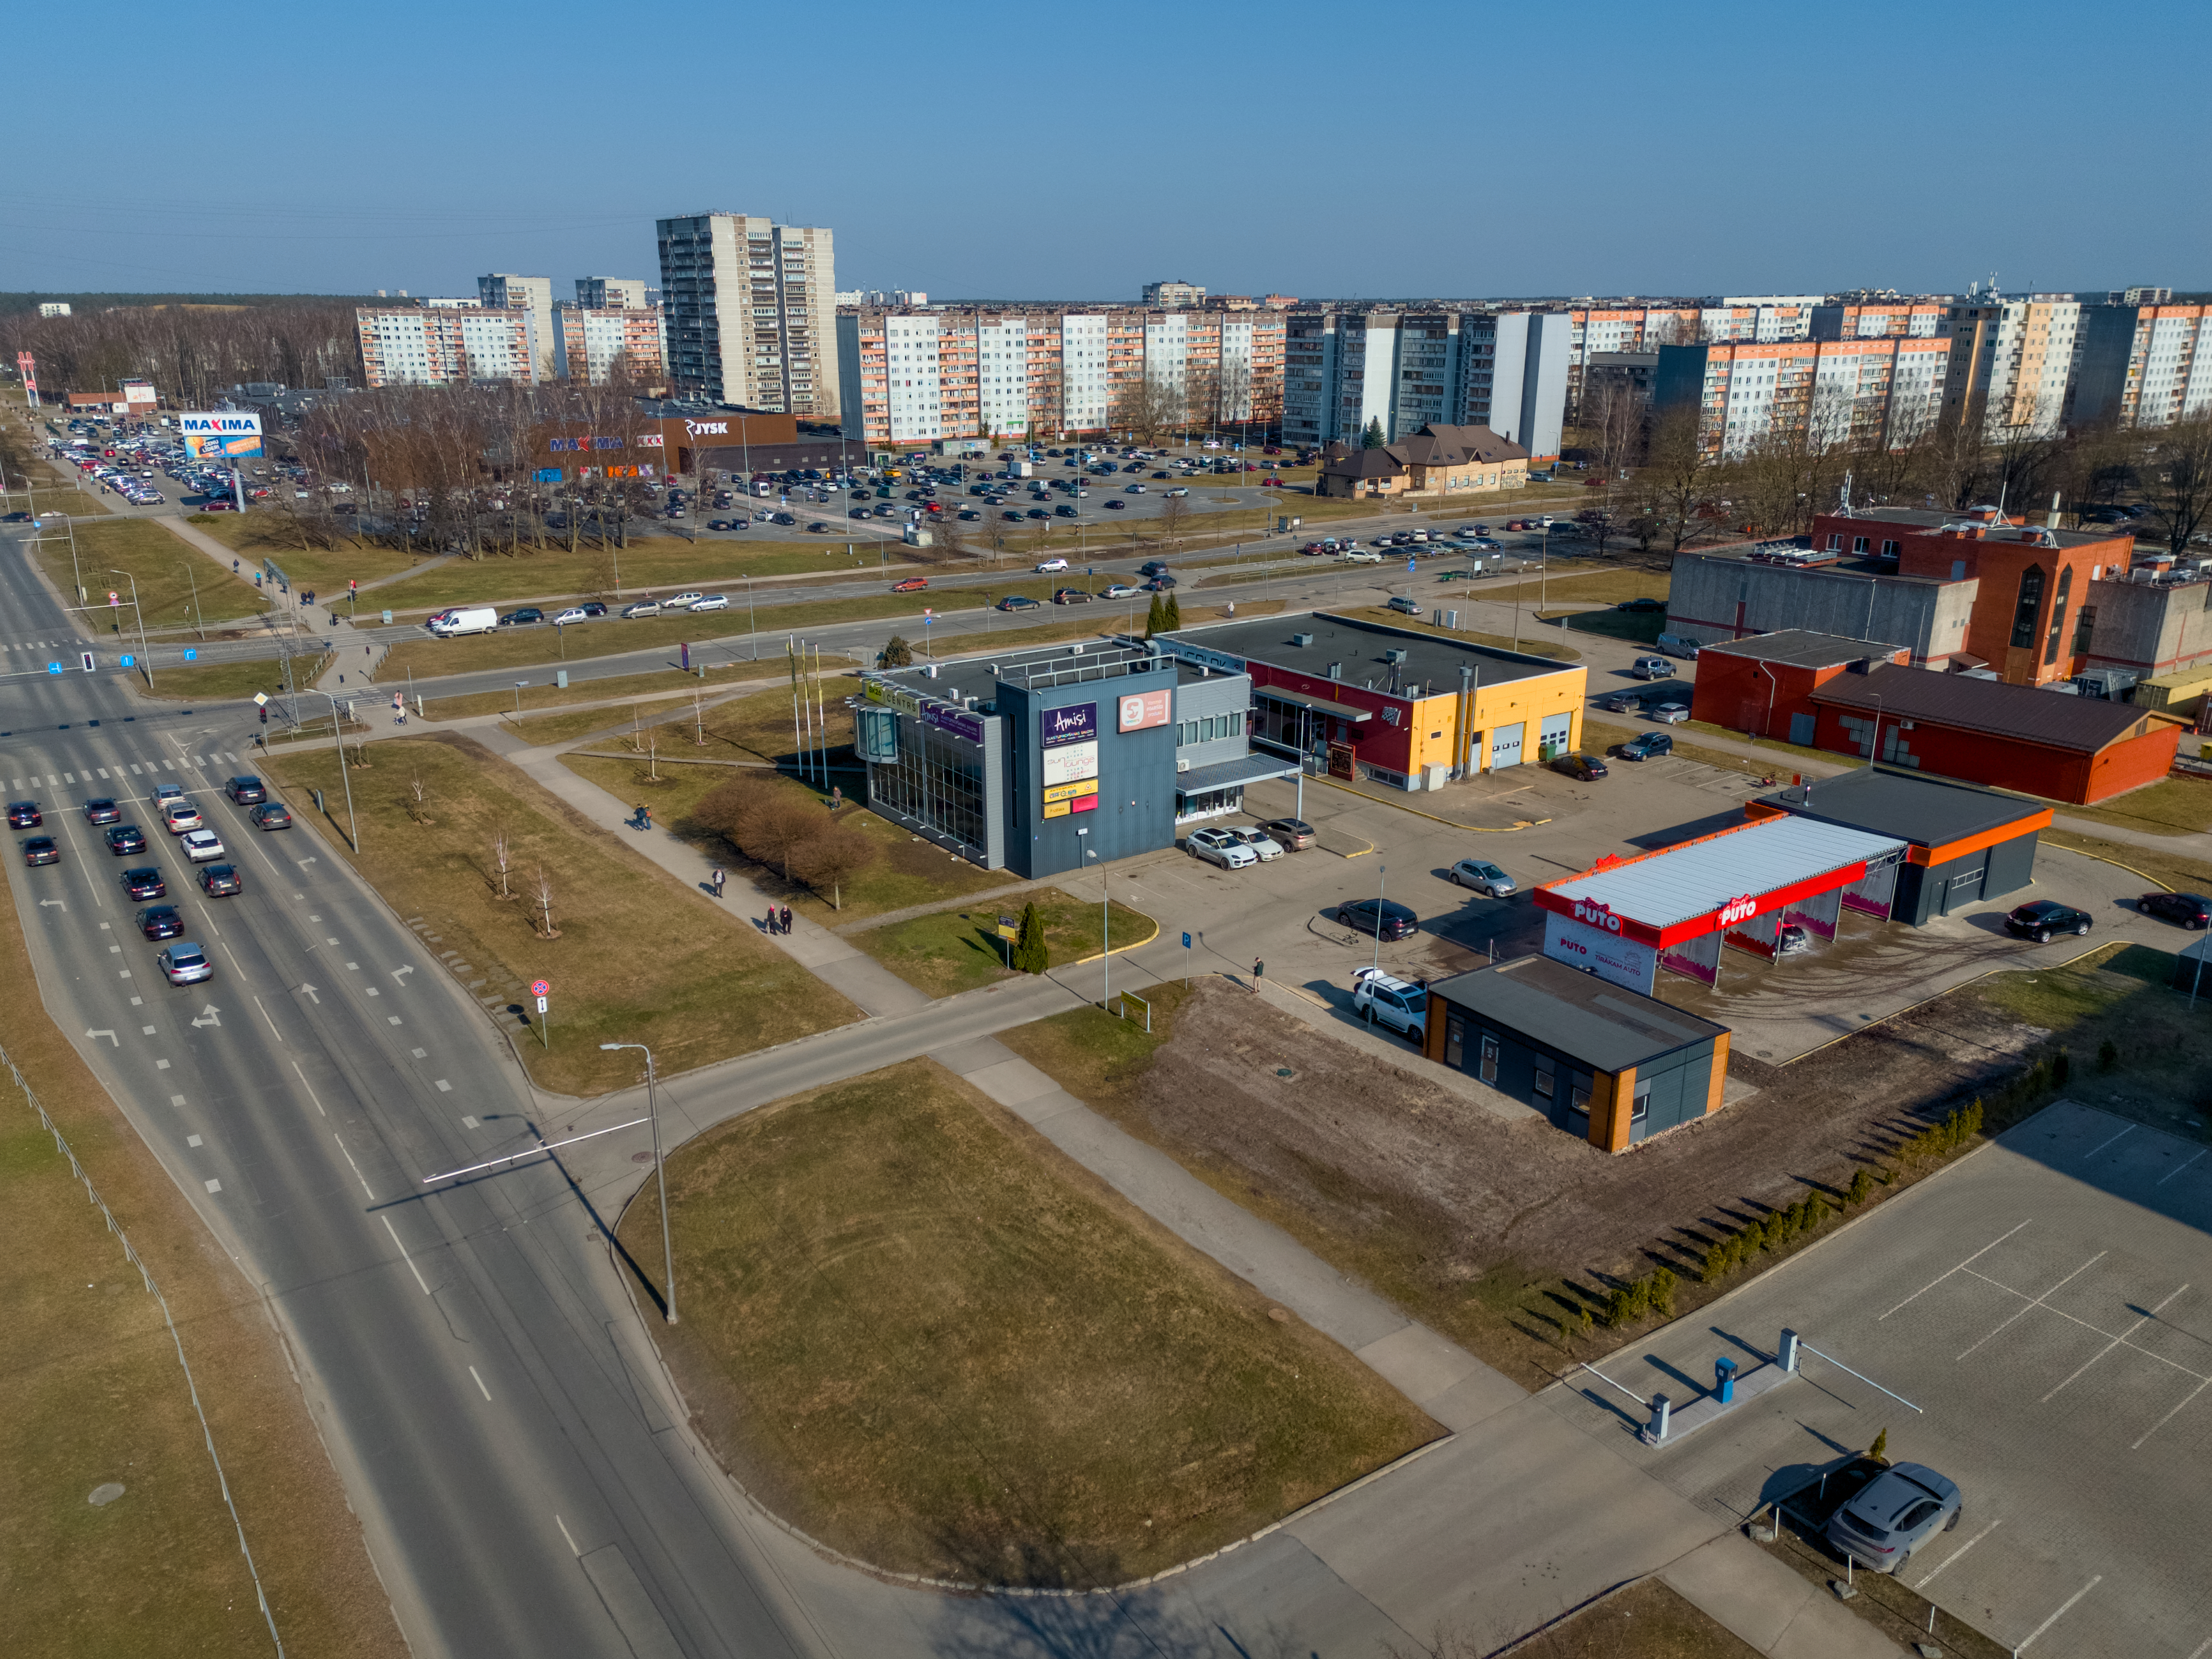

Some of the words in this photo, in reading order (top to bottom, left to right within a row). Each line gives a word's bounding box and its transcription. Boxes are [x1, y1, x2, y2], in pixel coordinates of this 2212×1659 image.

[184, 419, 255, 432] MAXIMA
[695, 422, 728, 435] JYSK
[887, 694, 916, 712] CENTRS
[921, 701, 939, 724] Amisi
[1054, 709, 1086, 731] Amisi
[1575, 904, 1620, 930] PUTO
[1722, 901, 1756, 926] PUTO
[1184, 934, 1189, 945] P
[1560, 937, 1587, 955] PUTO
[1623, 966, 1641, 976] AUTO
